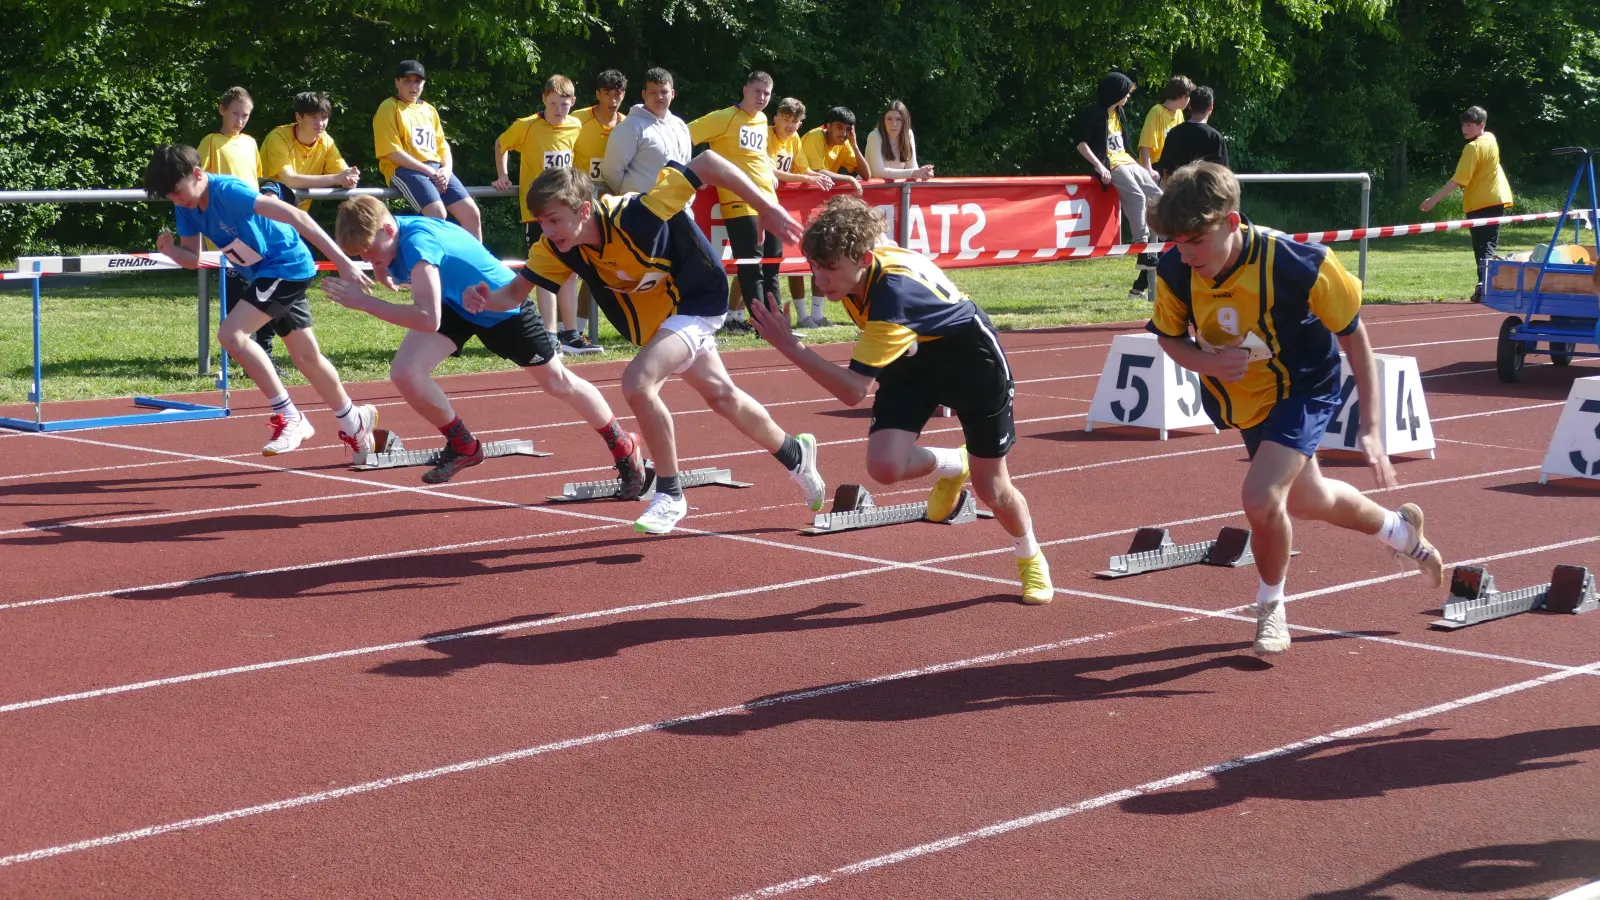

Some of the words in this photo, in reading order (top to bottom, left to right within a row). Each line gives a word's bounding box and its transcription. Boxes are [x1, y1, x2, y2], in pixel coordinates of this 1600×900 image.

[740, 129, 763, 150] 302
[1217, 307, 1238, 336] 9
[1110, 353, 1156, 423] 5
[1174, 361, 1202, 418] 5
[1325, 375, 1361, 448] 4
[1396, 370, 1420, 441] 4
[1568, 399, 1600, 476] 3
